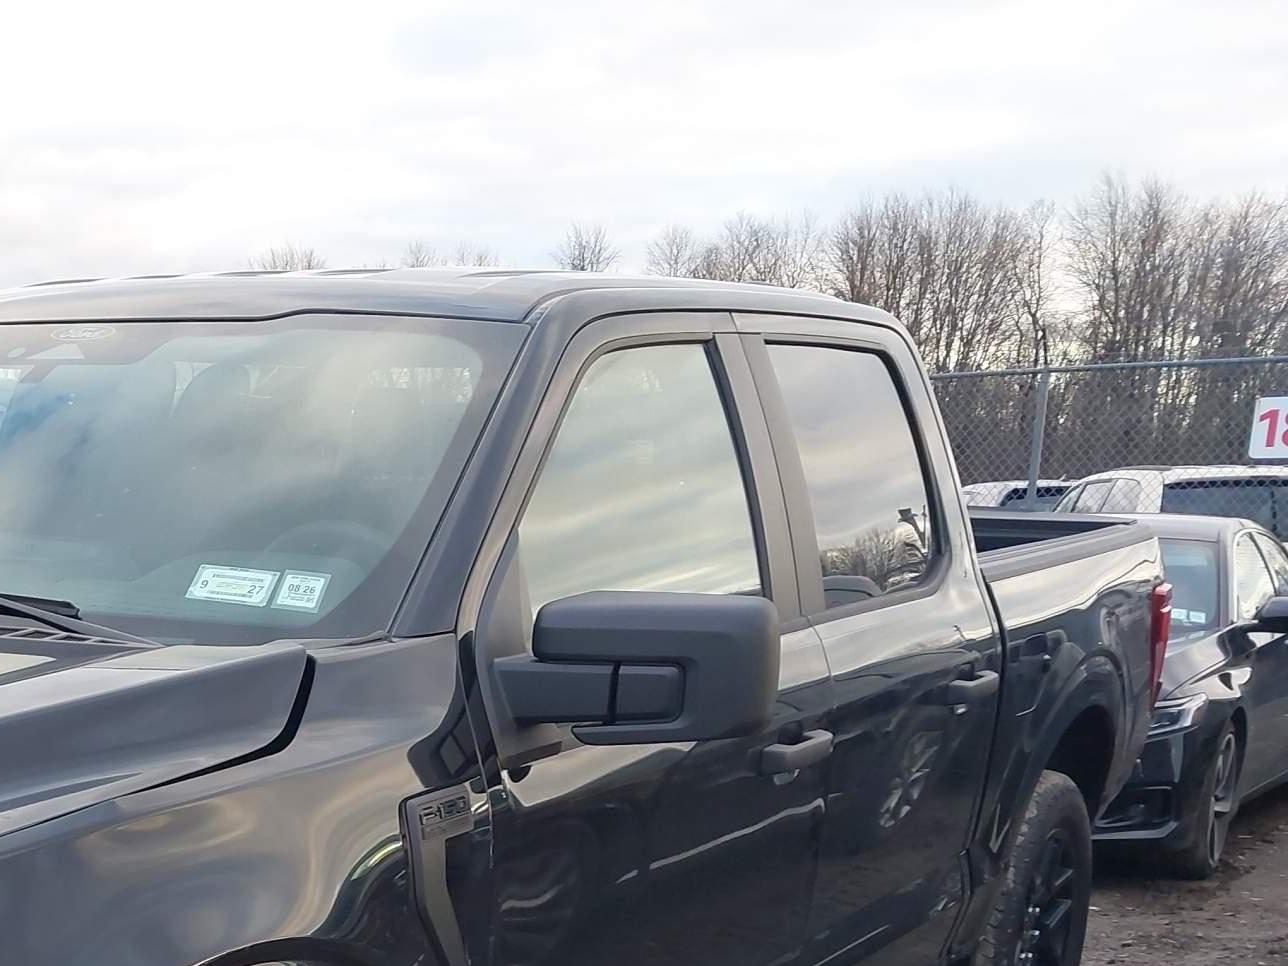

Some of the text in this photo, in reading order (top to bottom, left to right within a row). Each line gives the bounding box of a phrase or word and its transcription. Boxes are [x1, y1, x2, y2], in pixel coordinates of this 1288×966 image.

[1259, 409, 1288, 448] 1
[199, 579, 209, 589] 9
[247, 584, 265, 594] 27
